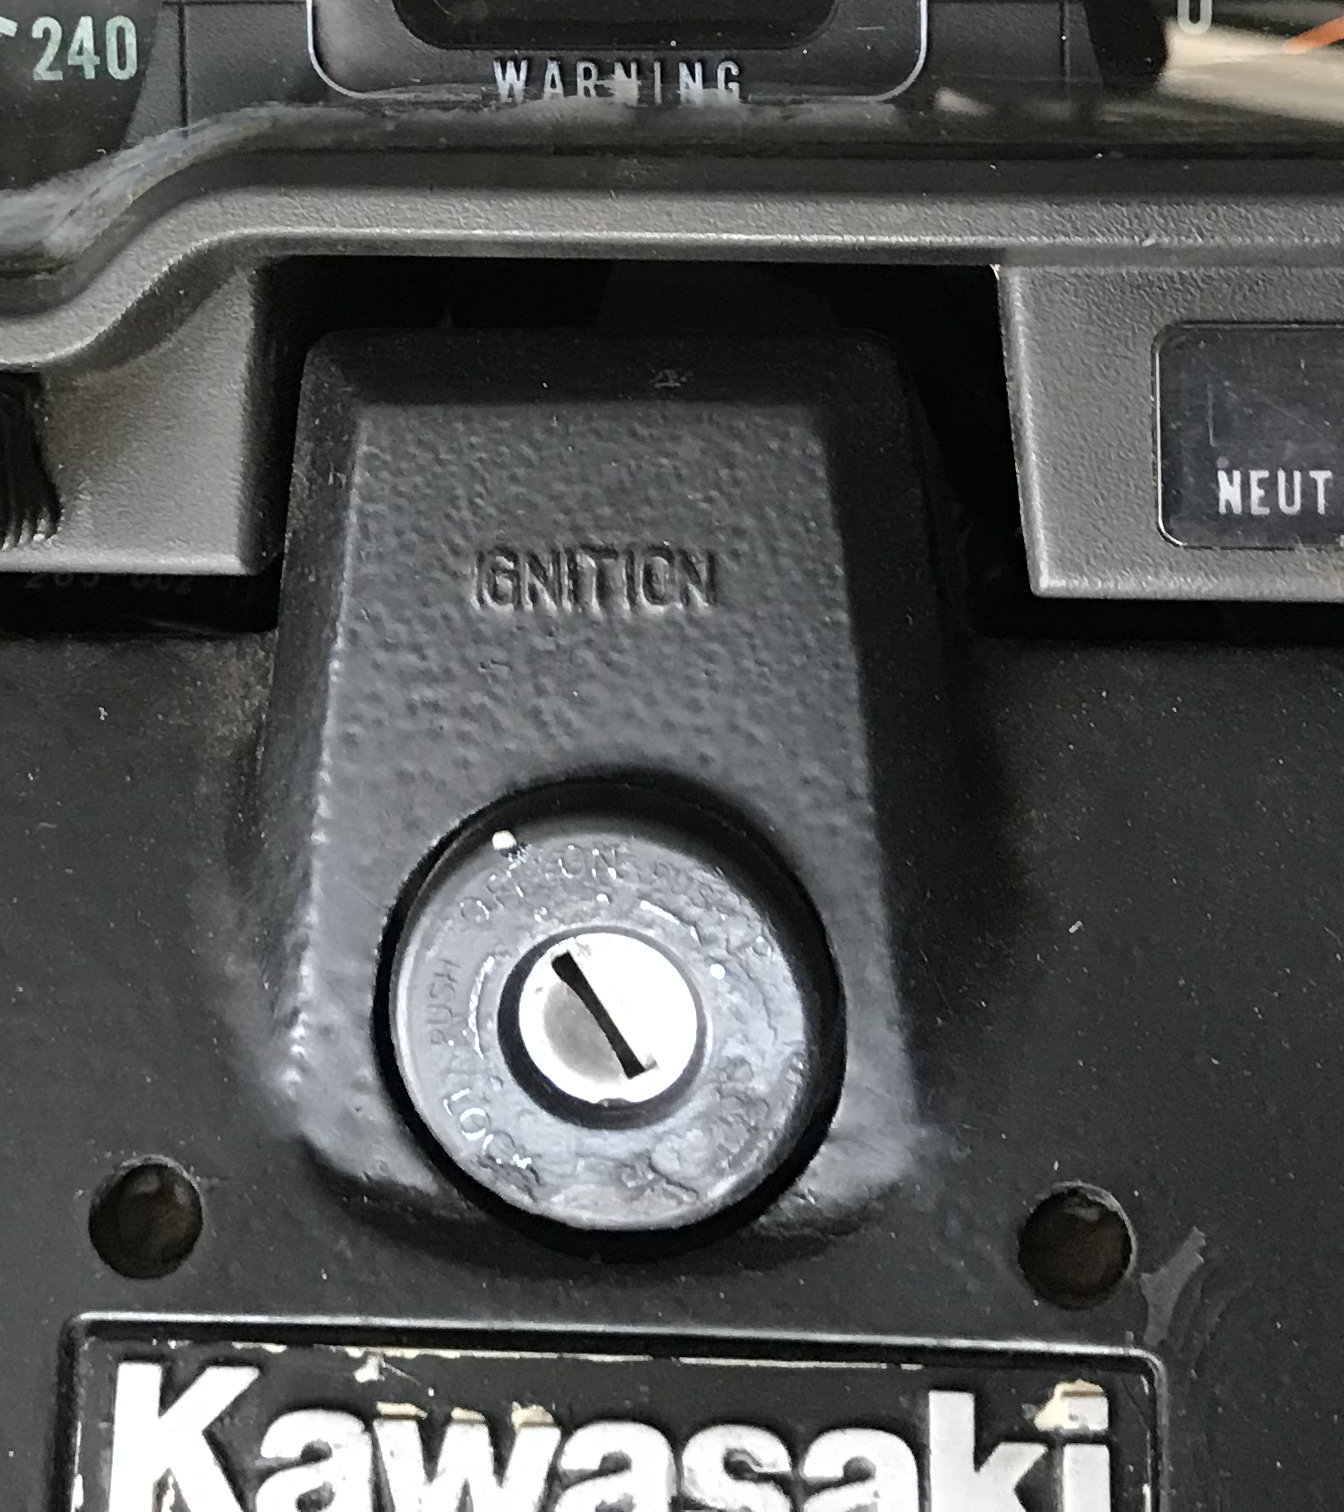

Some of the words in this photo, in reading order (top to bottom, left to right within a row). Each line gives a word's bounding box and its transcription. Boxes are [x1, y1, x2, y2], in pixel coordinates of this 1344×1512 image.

[31, 14, 138, 82] 240
[491, 58, 742, 105] WARNING
[469, 544, 721, 614] IGNITION
[109, 1360, 1111, 1512] Kawasaki
